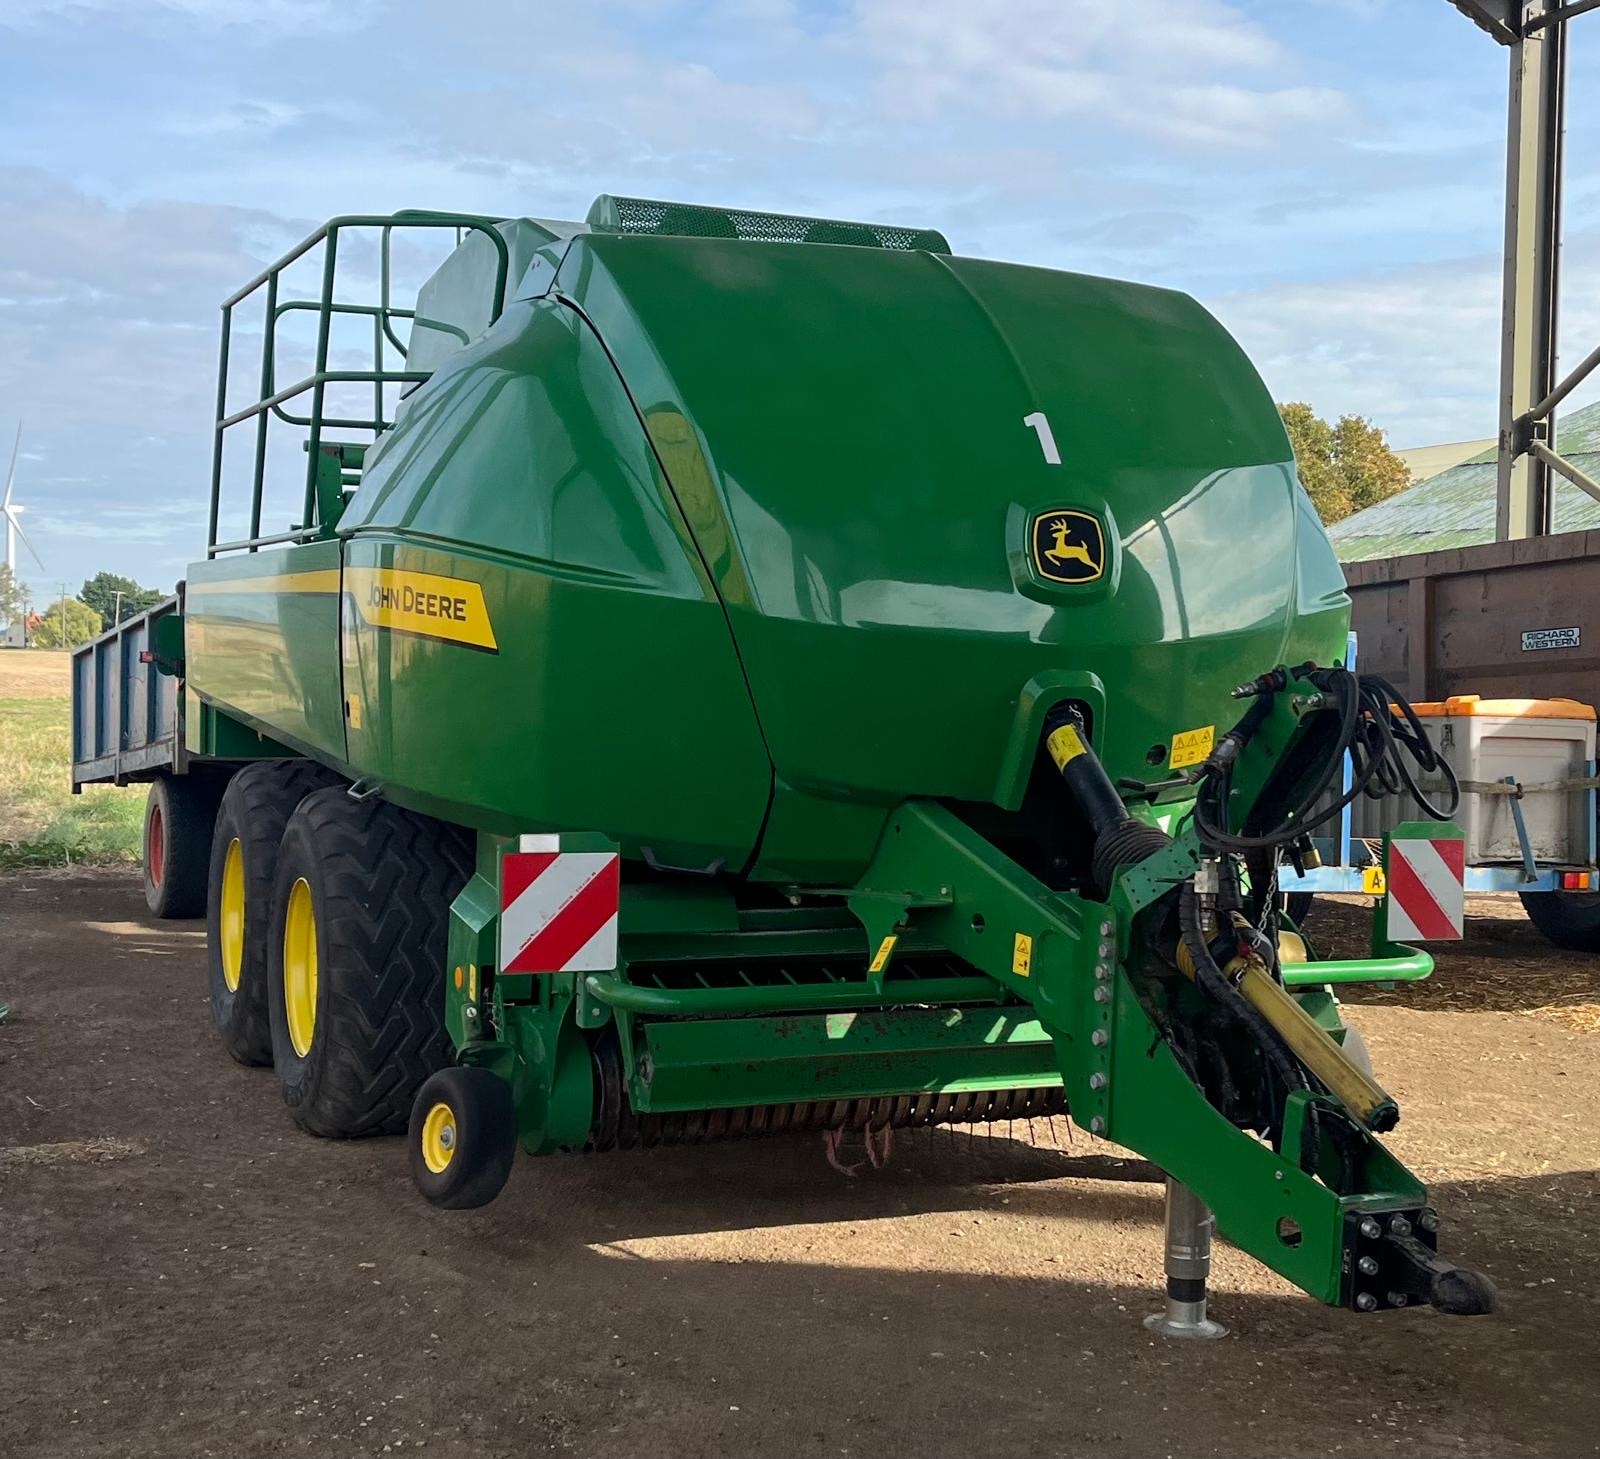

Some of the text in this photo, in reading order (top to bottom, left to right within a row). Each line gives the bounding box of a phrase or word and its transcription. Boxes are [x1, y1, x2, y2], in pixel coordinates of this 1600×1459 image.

[1023, 412, 1062, 465] 1
[368, 581, 467, 622] JOHN DEERE
[1525, 637, 1578, 649] WESTERN
[1526, 629, 1575, 641] RICHARD
